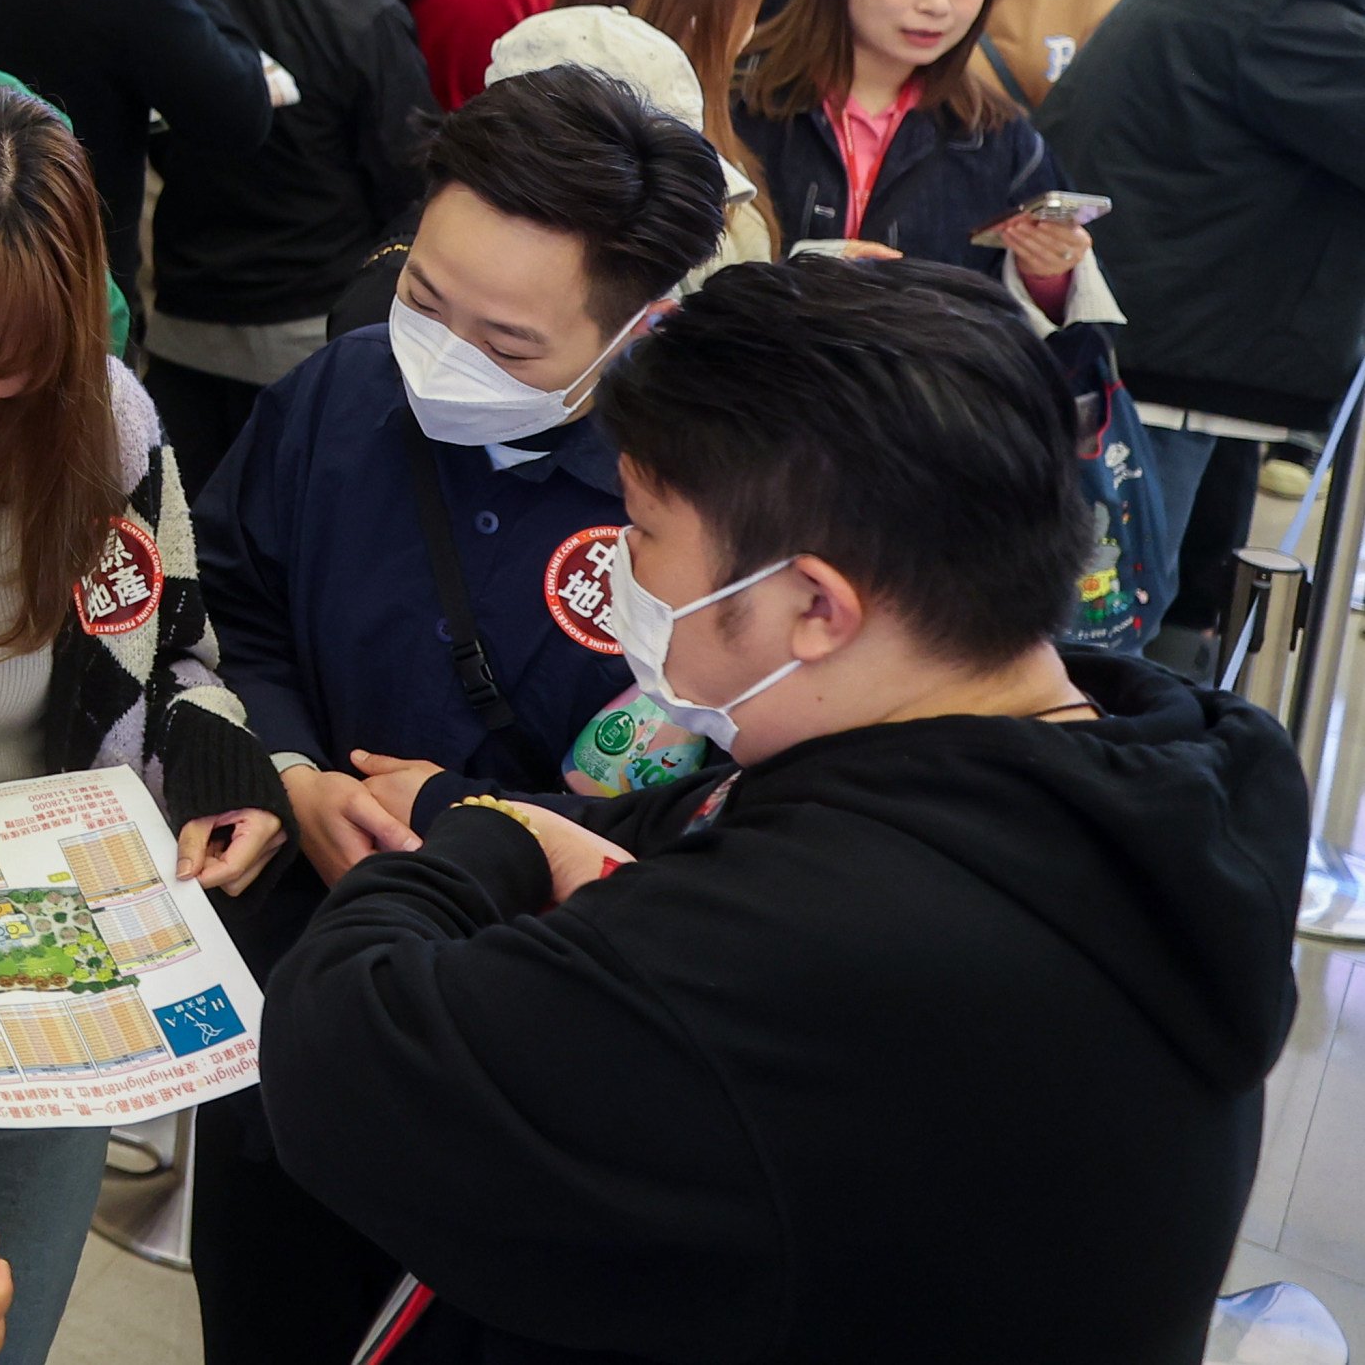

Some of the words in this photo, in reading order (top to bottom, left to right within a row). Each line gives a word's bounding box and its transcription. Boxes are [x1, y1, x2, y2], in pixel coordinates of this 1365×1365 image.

[120, 521, 161, 573] CENTANET.COM
[547, 536, 581, 596] CENTANET.COM
[588, 527, 622, 538] CENTA
[584, 540, 618, 579] 中
[86, 563, 152, 623] 地產
[136, 581, 161, 623] CENTALINE
[94, 616, 138, 633] PROPERTY
[550, 604, 588, 643] PROPERTY
[587, 636, 624, 653] TALINE
[28, 790, 66, 803] $18000
[32, 797, 70, 812] $28000
[164, 997, 226, 1028] HAVA
